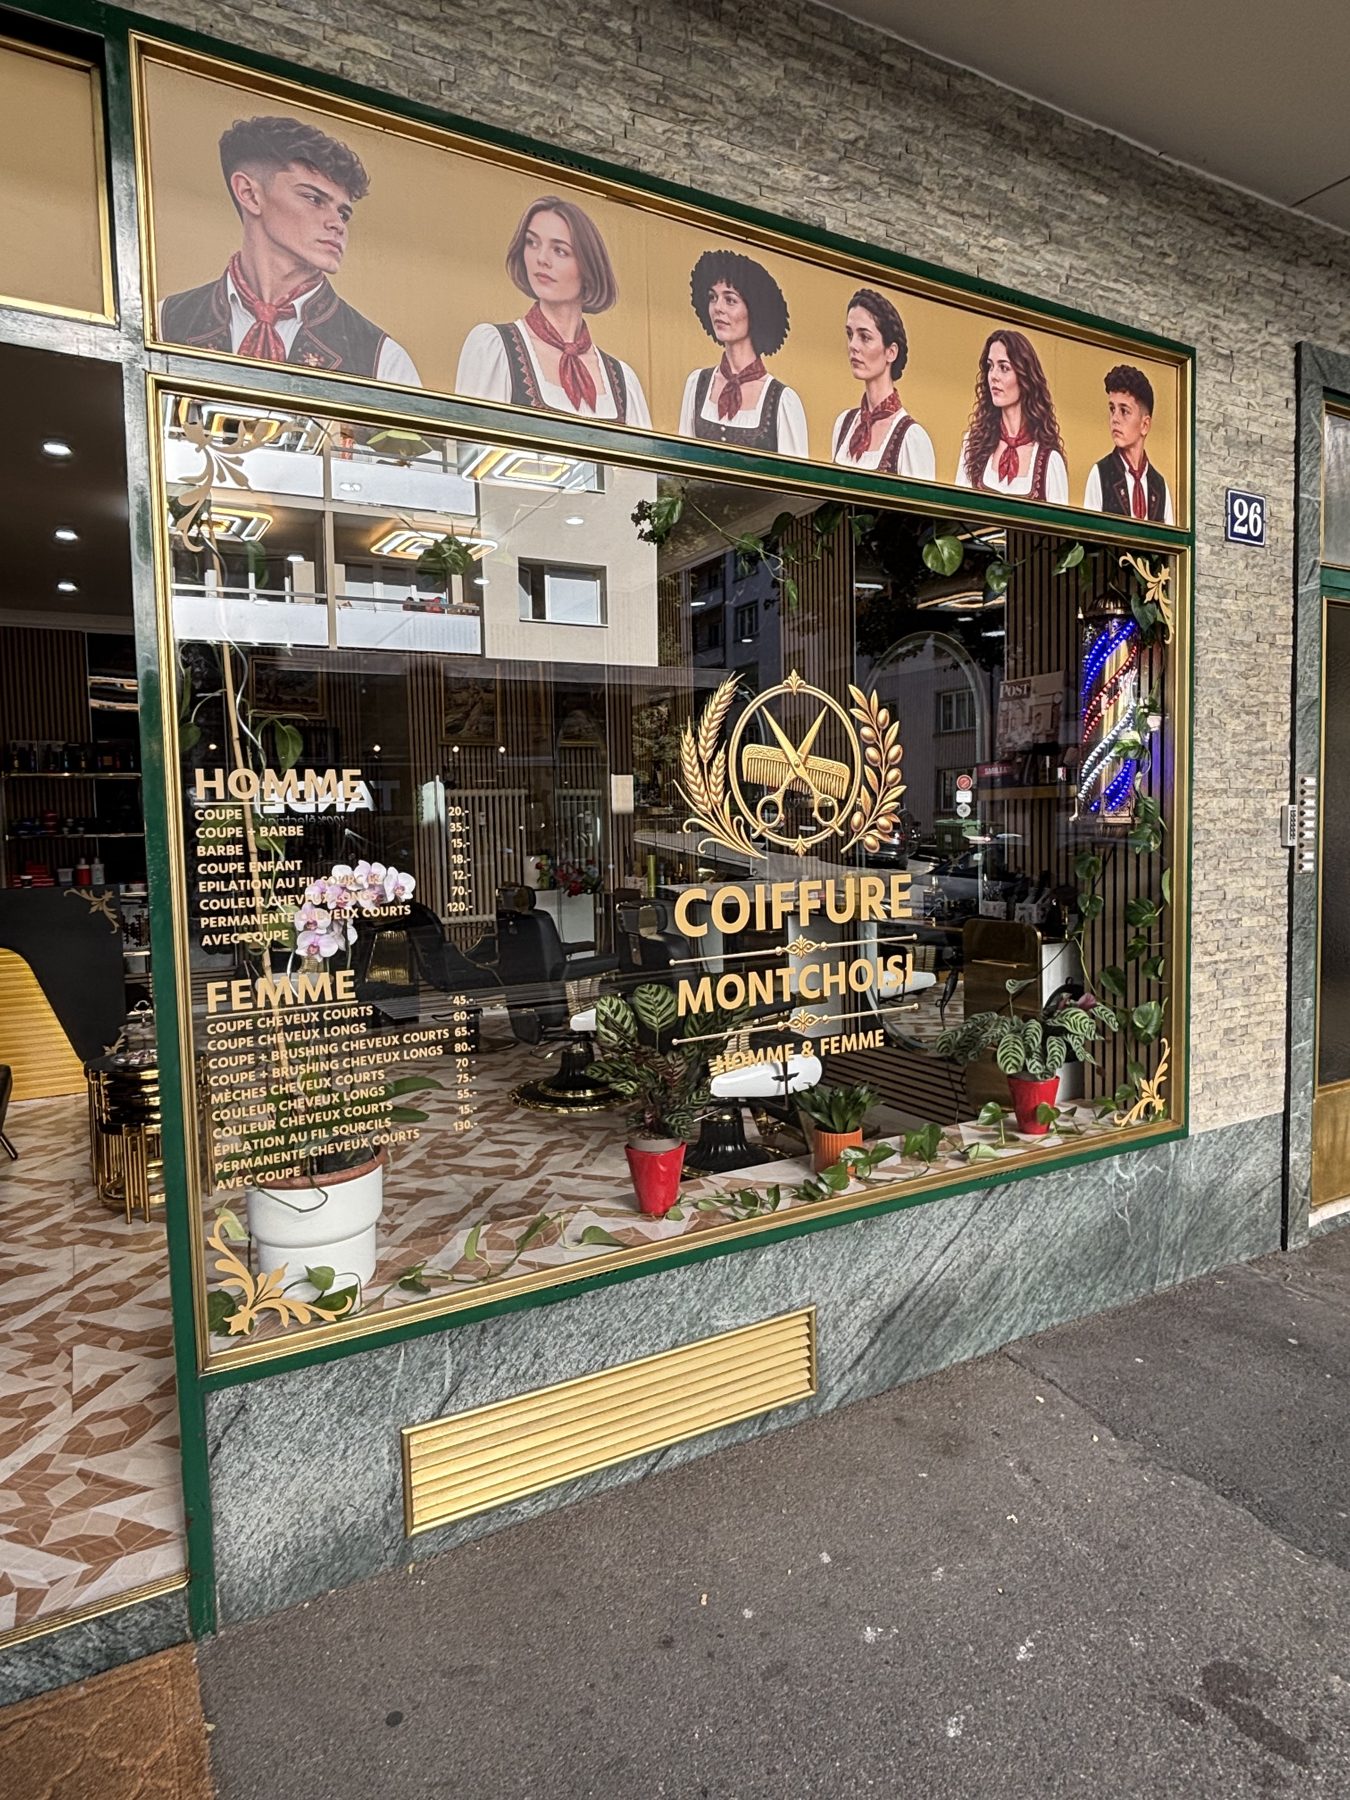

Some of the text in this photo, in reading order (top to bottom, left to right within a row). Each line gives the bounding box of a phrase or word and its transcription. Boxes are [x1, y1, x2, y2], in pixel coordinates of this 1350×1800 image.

[1233, 498, 1262, 537] 26
[1000, 683, 1030, 699] POST
[194, 768, 361, 800] HOMME
[194, 809, 243, 820] COUPE
[448, 806, 469, 816] 20.-
[195, 825, 304, 839] COUPE + BARBE
[449, 822, 470, 832] 35.-
[196, 844, 244, 857] BARBE
[451, 838, 471, 848] 15.-
[451, 854, 471, 864] 18.-
[197, 860, 302, 875] COUPE ENFANT
[452, 870, 471, 880] 12.-
[198, 879, 272, 893] EPILATION
[276, 877, 295, 889] AU
[452, 886, 472, 896] 70.-
[199, 896, 265, 910] COULEUR
[447, 902, 473, 912] 120.-
[674, 873, 912, 938] COIFFURE
[200, 912, 294, 929] PERMANENTE
[362, 904, 411, 918] COURTS
[201, 929, 289, 947] AVEC COUPE
[207, 970, 356, 1013] FEMME
[677, 953, 913, 1017] MONTCHOISI
[453, 995, 473, 1005] 45.-
[207, 1005, 373, 1035] COUPE CHEVEUX COURTS
[453, 1011, 474, 1022] 60.-
[207, 1023, 367, 1051] COUPE CHEVEUX LONGS
[454, 1026, 475, 1037] 65.-
[208, 1029, 449, 1069] COUPE + BRUSHING CHEVEUX COURTS
[454, 1042, 475, 1053] 80.-
[715, 1029, 885, 1073] HOMME & FEMME
[210, 1045, 443, 1087] COUPE + BRUSHING CHEVEUX LONGS
[456, 1073, 476, 1084] 75.-
[211, 1069, 385, 1104] MÈCHES CHEVEUX COURTS
[457, 1089, 477, 1099] 55.-
[212, 1086, 385, 1121] COULEUR CHEVEUX LONGS
[458, 1104, 477, 1115] 15.-
[212, 1101, 393, 1139] COULEUR CHEVEUX COURTS
[453, 1120, 478, 1131] 130.-
[213, 1117, 392, 1156] ÉPILATION AU FIL SOURCILS
[214, 1129, 420, 1174] PERMANENTE CHEVEUX COURTS
[216, 1166, 300, 1191] AVEC COUPE
